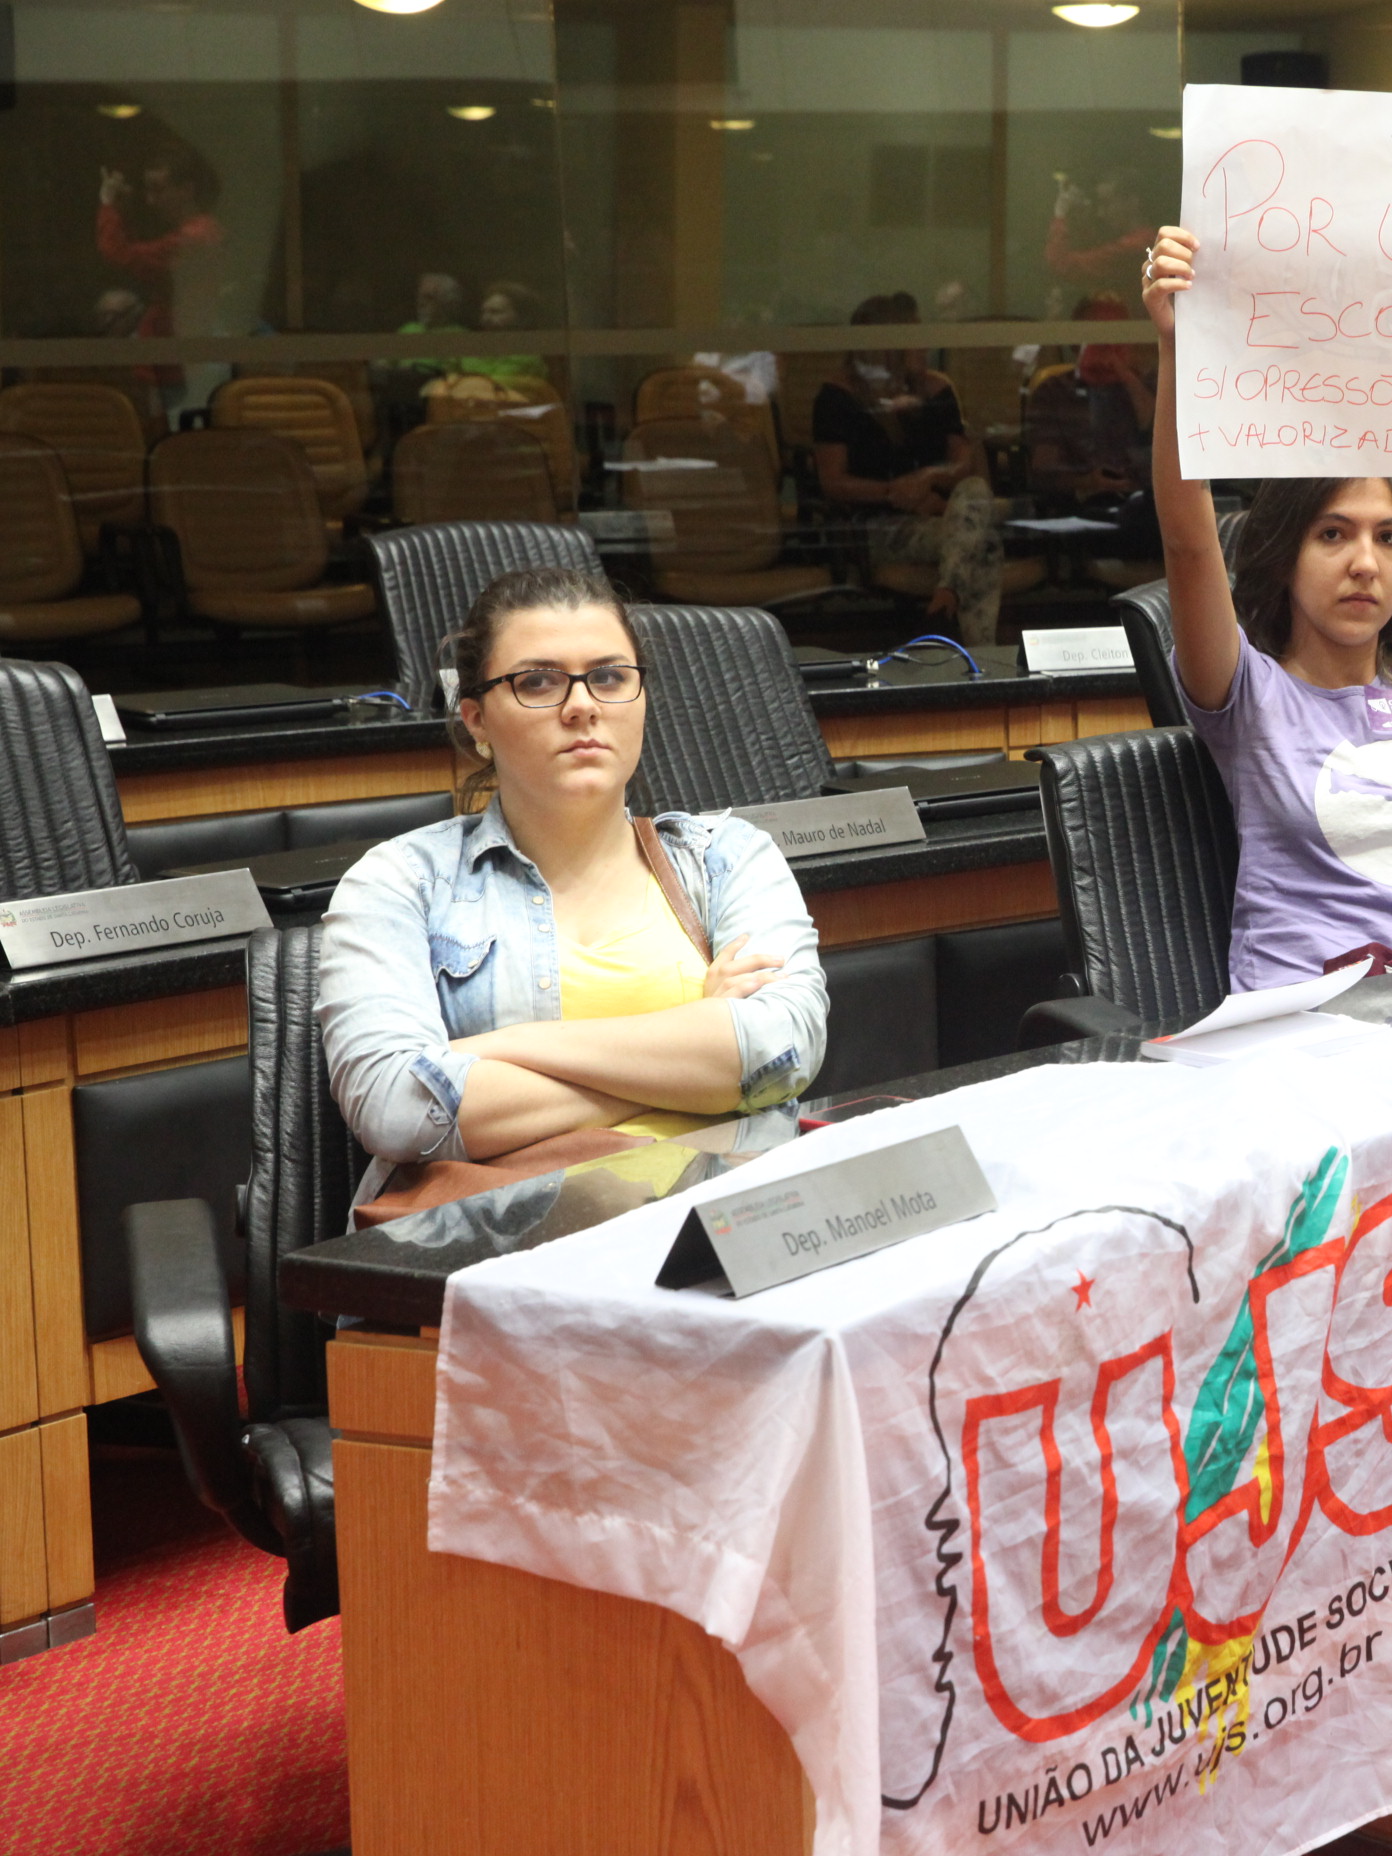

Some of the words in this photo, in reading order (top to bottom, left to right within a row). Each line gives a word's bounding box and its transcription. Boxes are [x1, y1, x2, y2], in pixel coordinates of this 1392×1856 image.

[1202, 138, 1347, 257] POR
[1062, 650, 1088, 664] Dep.
[1091, 647, 1129, 661] Cleiton
[782, 829, 826, 847] Mauro
[829, 825, 846, 840] de
[848, 818, 887, 838] Nadal
[50, 930, 91, 949] Dep.
[94, 915, 170, 941] Fernando
[173, 907, 225, 930] Coruja
[782, 1231, 828, 1256] Dep.
[825, 1199, 893, 1242] Manoel
[891, 1189, 938, 1222] Mota
[977, 1762, 1094, 1835] UNIÃO
[1101, 1734, 1146, 1786] DA
[1151, 1609, 1318, 1758] JUVENTUDE
[1081, 1629, 1384, 1848] www.ujs.org.br
